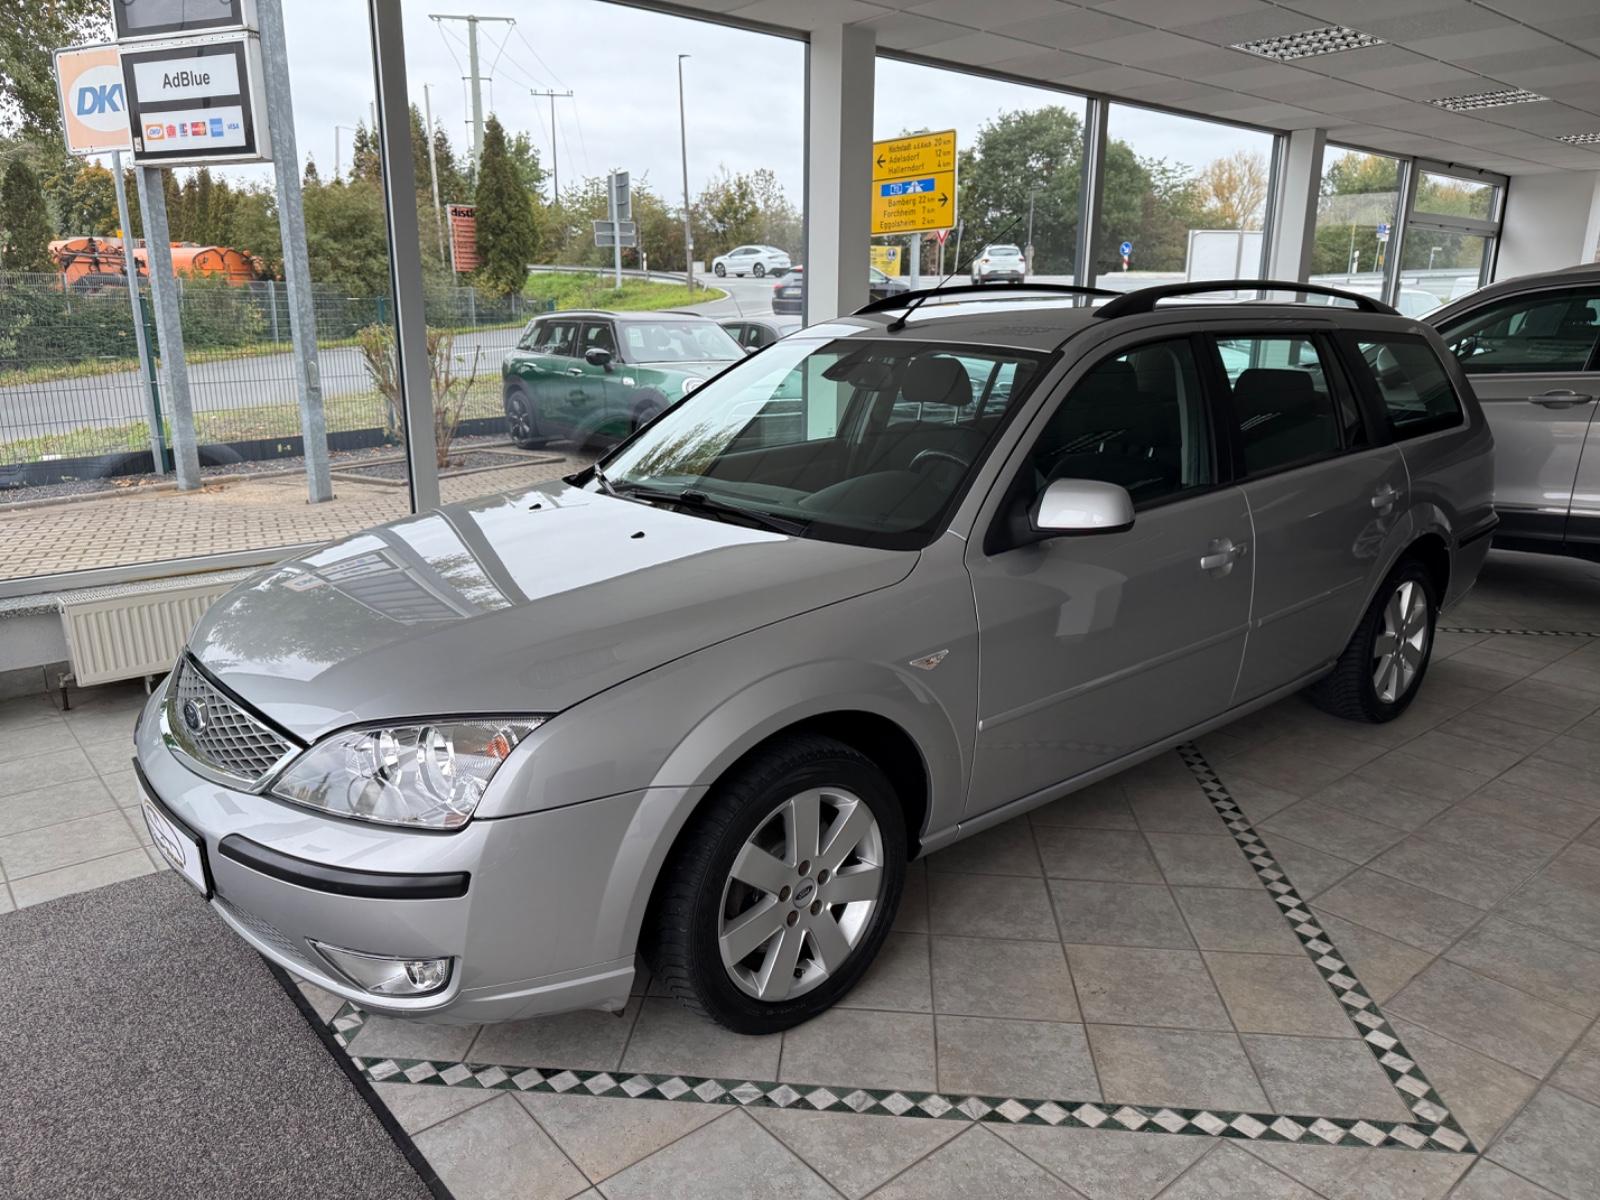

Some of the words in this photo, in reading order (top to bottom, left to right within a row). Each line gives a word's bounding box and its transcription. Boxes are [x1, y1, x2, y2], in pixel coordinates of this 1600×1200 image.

[162, 70, 211, 89] AdBlue
[227, 122, 240, 130] VISA
[889, 152, 920, 163] Adelsdorf
[888, 198, 916, 207] Bamberg
[918, 195, 926, 204] 22
[883, 209, 916, 218] Forchheim
[880, 219, 916, 230] Eggolsheim
